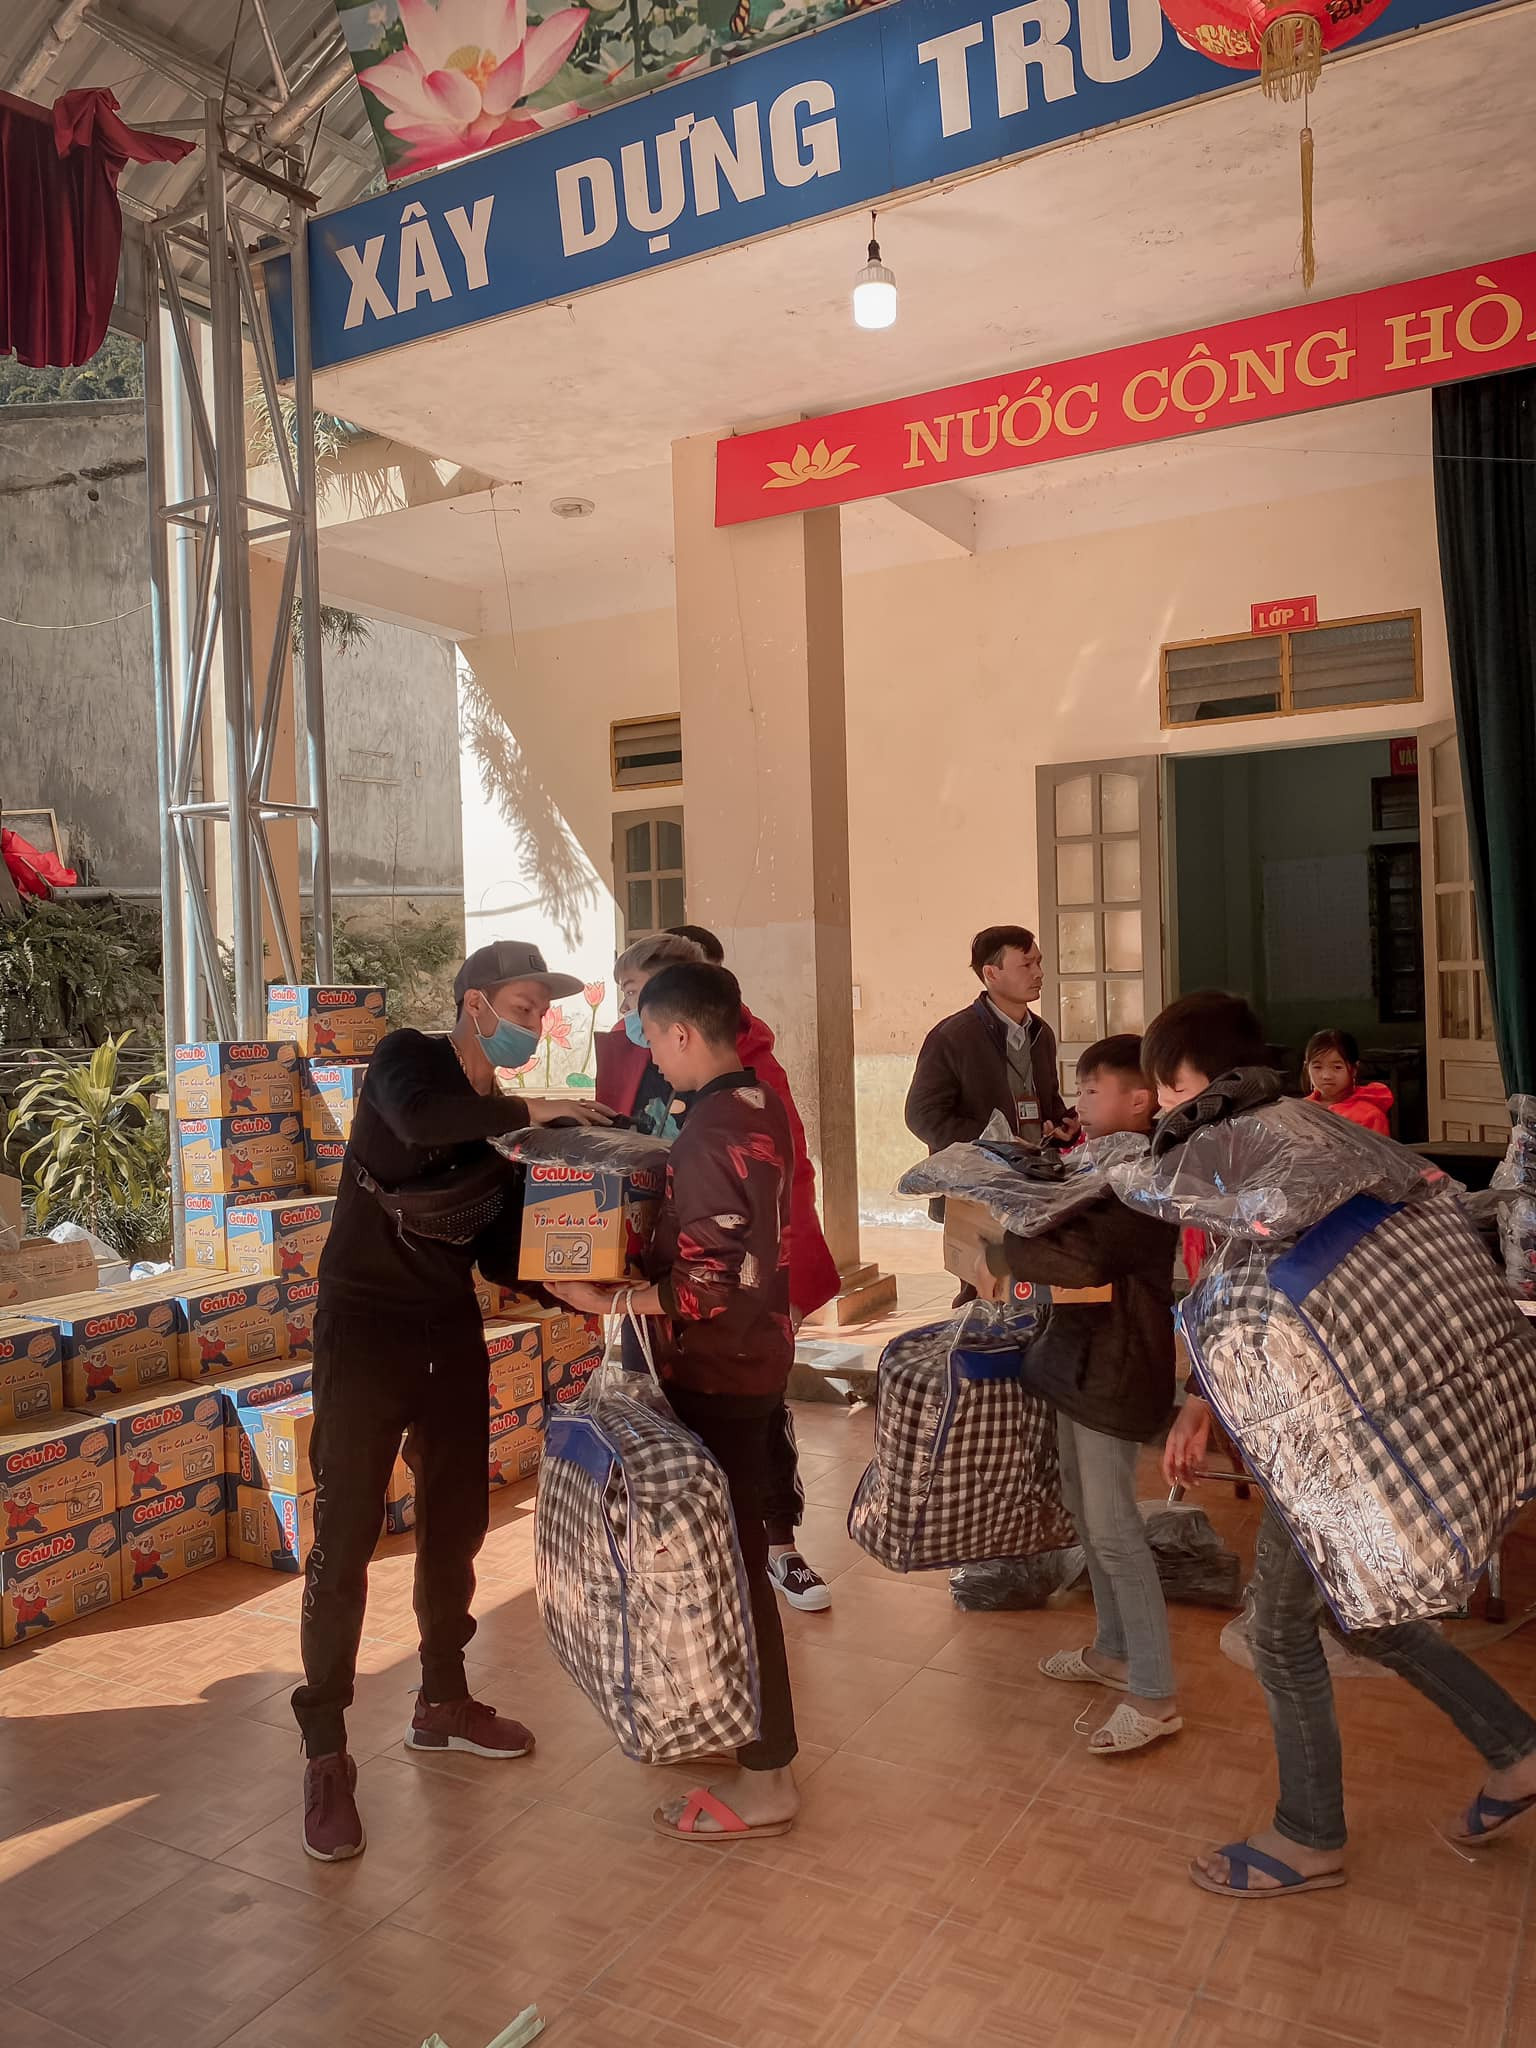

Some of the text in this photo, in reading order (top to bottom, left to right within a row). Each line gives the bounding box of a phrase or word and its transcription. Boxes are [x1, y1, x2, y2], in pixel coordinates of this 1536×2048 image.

[335, 195, 494, 330] XÂY
[556, 80, 841, 257] DỰNG
[902, 275, 1536, 470] NƯỚC CỘNG HÒ
[1259, 605, 1310, 628] LỚP 1
[533, 1211, 609, 1229] Tôm Chua Cay
